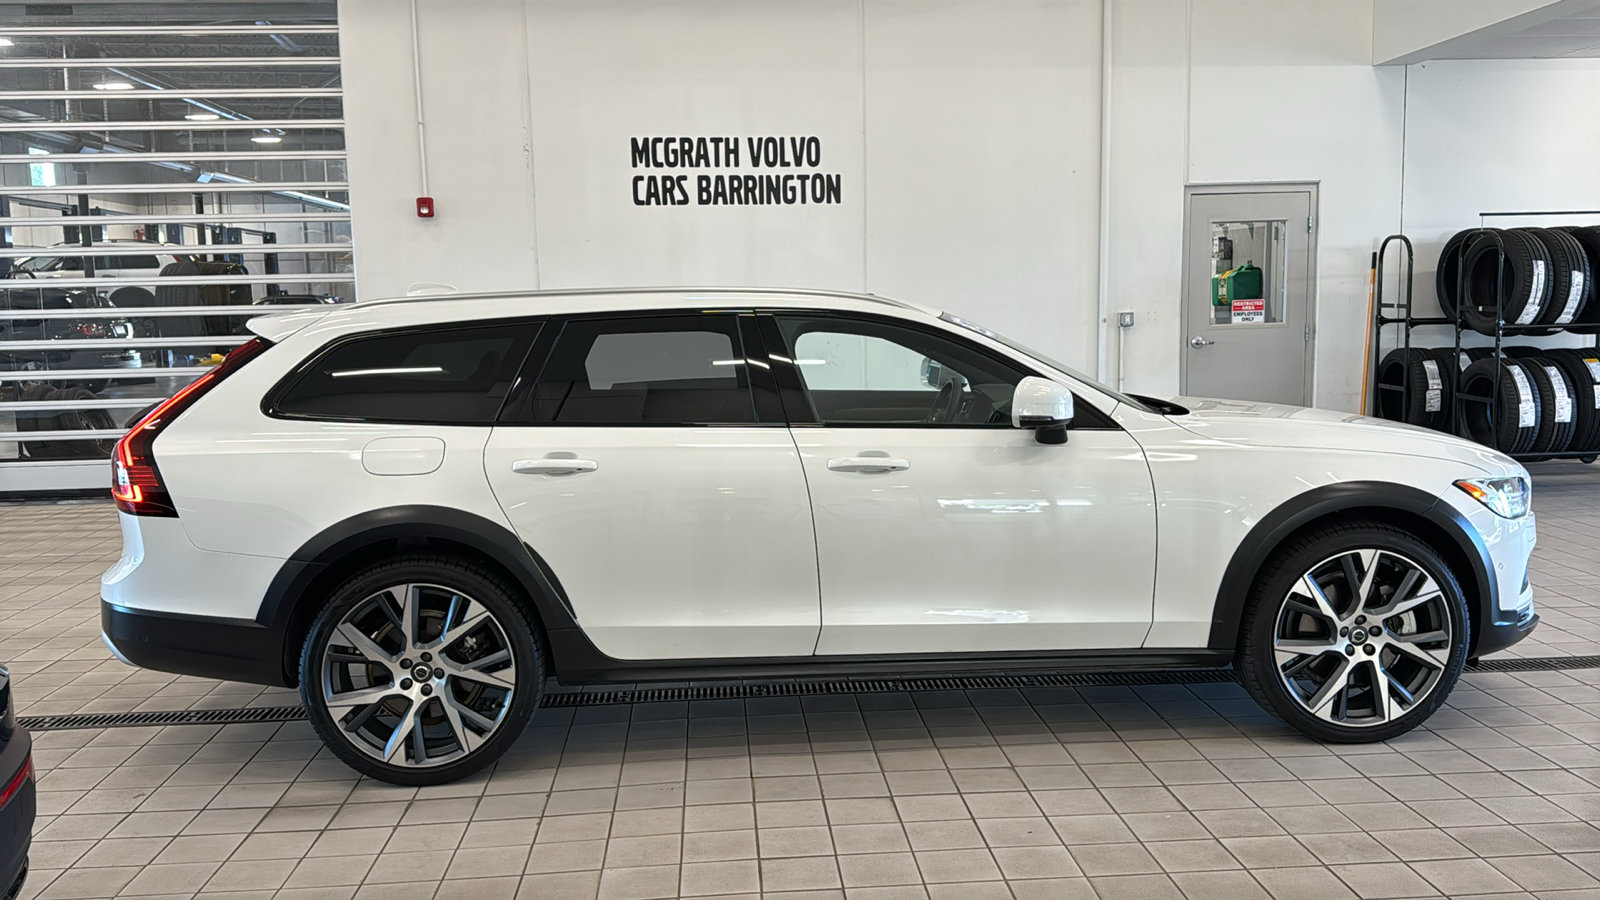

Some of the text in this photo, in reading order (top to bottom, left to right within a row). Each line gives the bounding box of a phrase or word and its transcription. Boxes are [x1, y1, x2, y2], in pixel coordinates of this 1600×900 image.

[631, 136, 821, 168] MCGRATH VOLVO
[632, 173, 842, 206] CARS BARRINGTON
